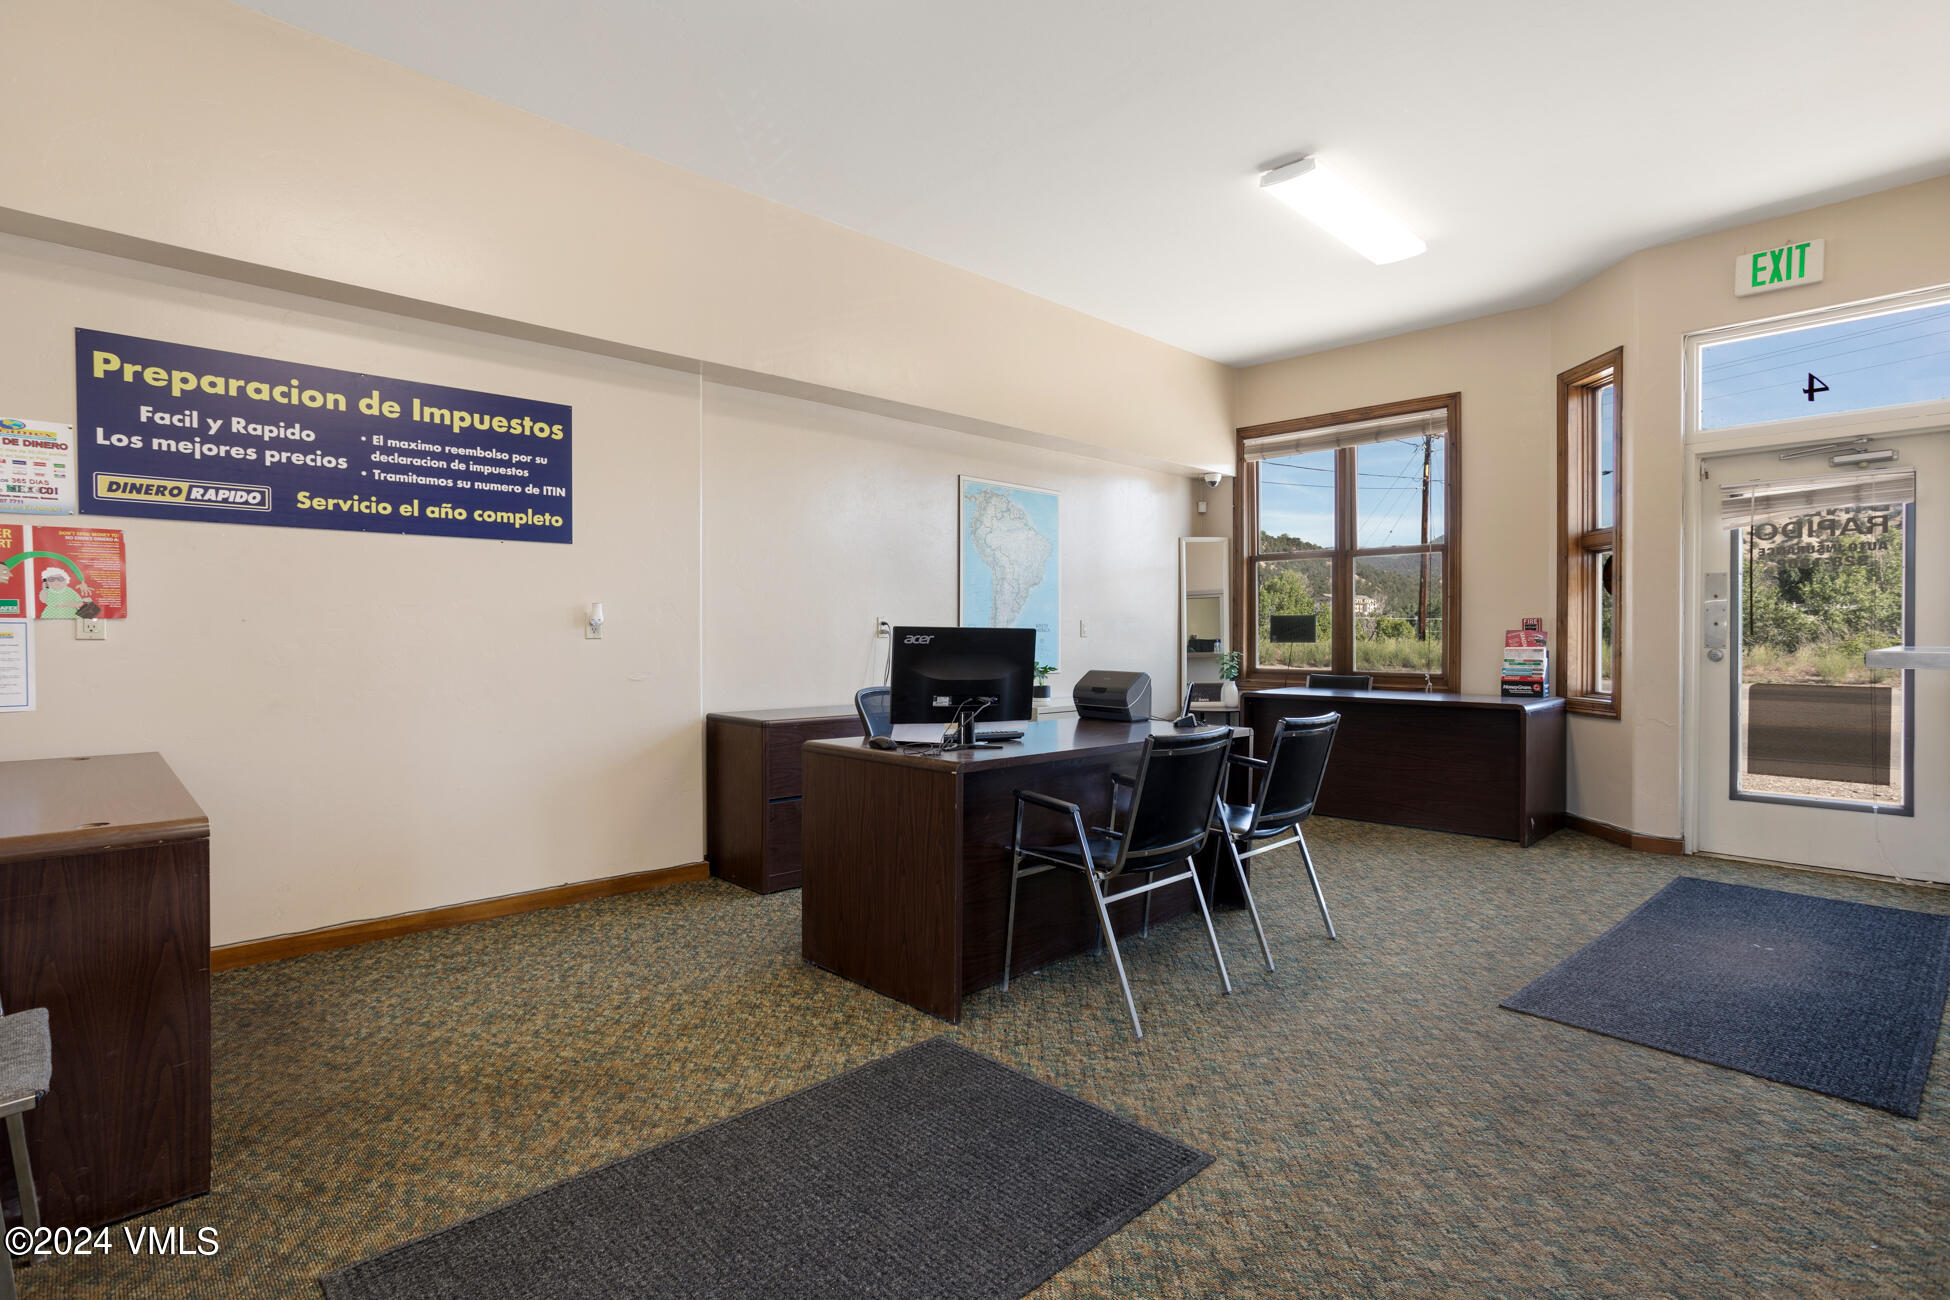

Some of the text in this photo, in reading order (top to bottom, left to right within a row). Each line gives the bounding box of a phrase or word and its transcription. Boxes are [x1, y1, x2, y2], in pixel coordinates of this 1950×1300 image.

[1752, 243, 1811, 287] EXIT
[93, 350, 564, 440] Preparacion de Impuestos
[139, 405, 316, 442] Facil y Rapido
[2, 437, 68, 451] DE DINERO
[95, 427, 348, 469] Los mejores precios
[372, 435, 548, 465] El maximo reembolso por su
[371, 451, 529, 477] declaracion de impuestos
[106, 480, 262, 504] DINERO RAPIDO
[373, 469, 566, 497] Tramitamos su numero de ITIN
[296, 491, 564, 529] Servicio el año completo
[904, 634, 935, 645] acer
